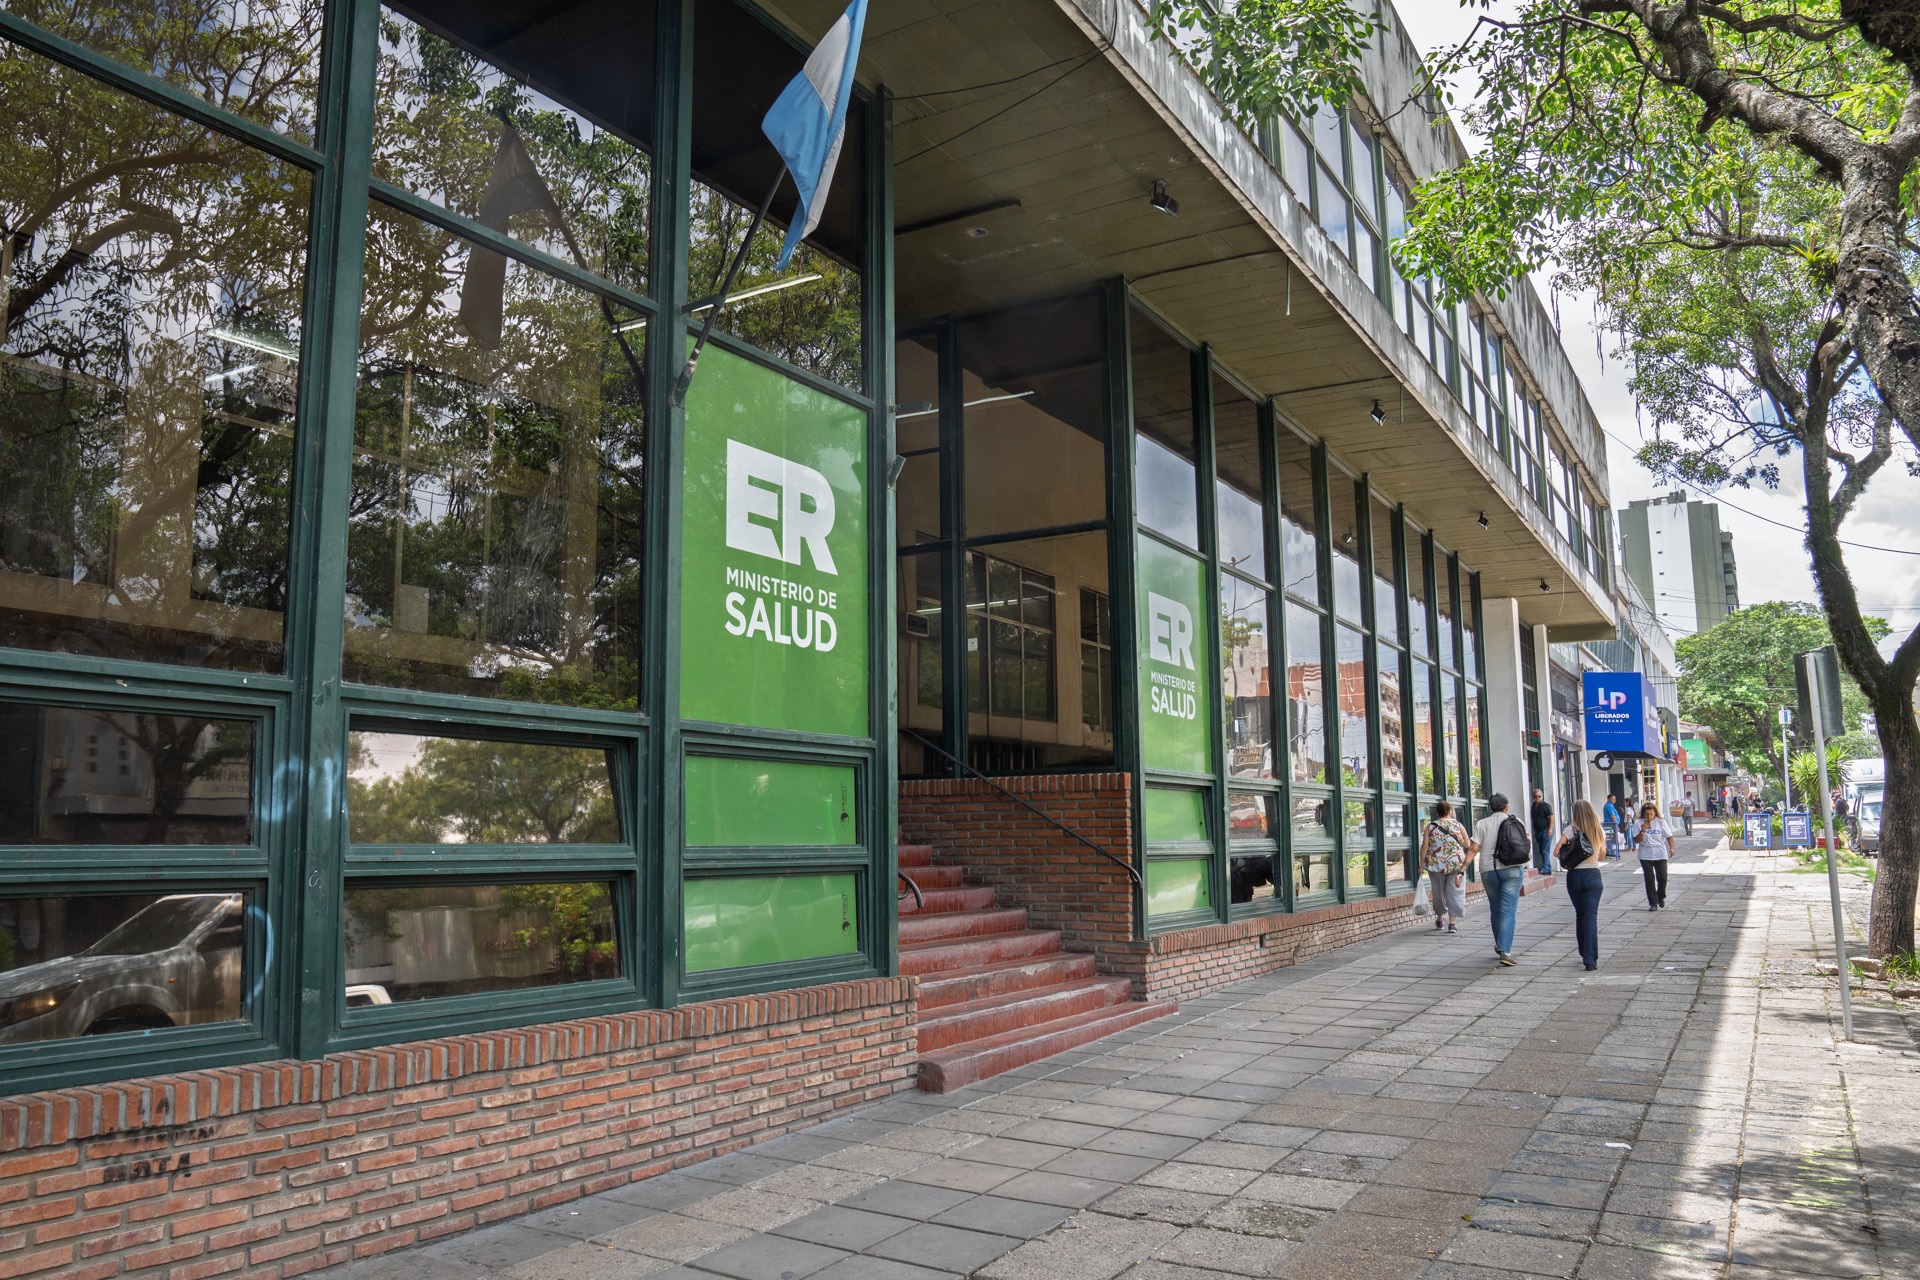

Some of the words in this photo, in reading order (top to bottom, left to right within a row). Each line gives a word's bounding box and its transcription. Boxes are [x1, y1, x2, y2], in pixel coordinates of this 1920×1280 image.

[726, 438, 838, 576] ER
[726, 566, 814, 604] MINISTERIO
[818, 589, 837, 610] DE
[724, 591, 837, 652] SALUD
[1148, 591, 1195, 671] ER
[1151, 670, 1186, 690] MINISTERIO
[1187, 681, 1196, 692] DE
[1151, 685, 1196, 720] SALUD
[1598, 687, 1627, 710] LP
